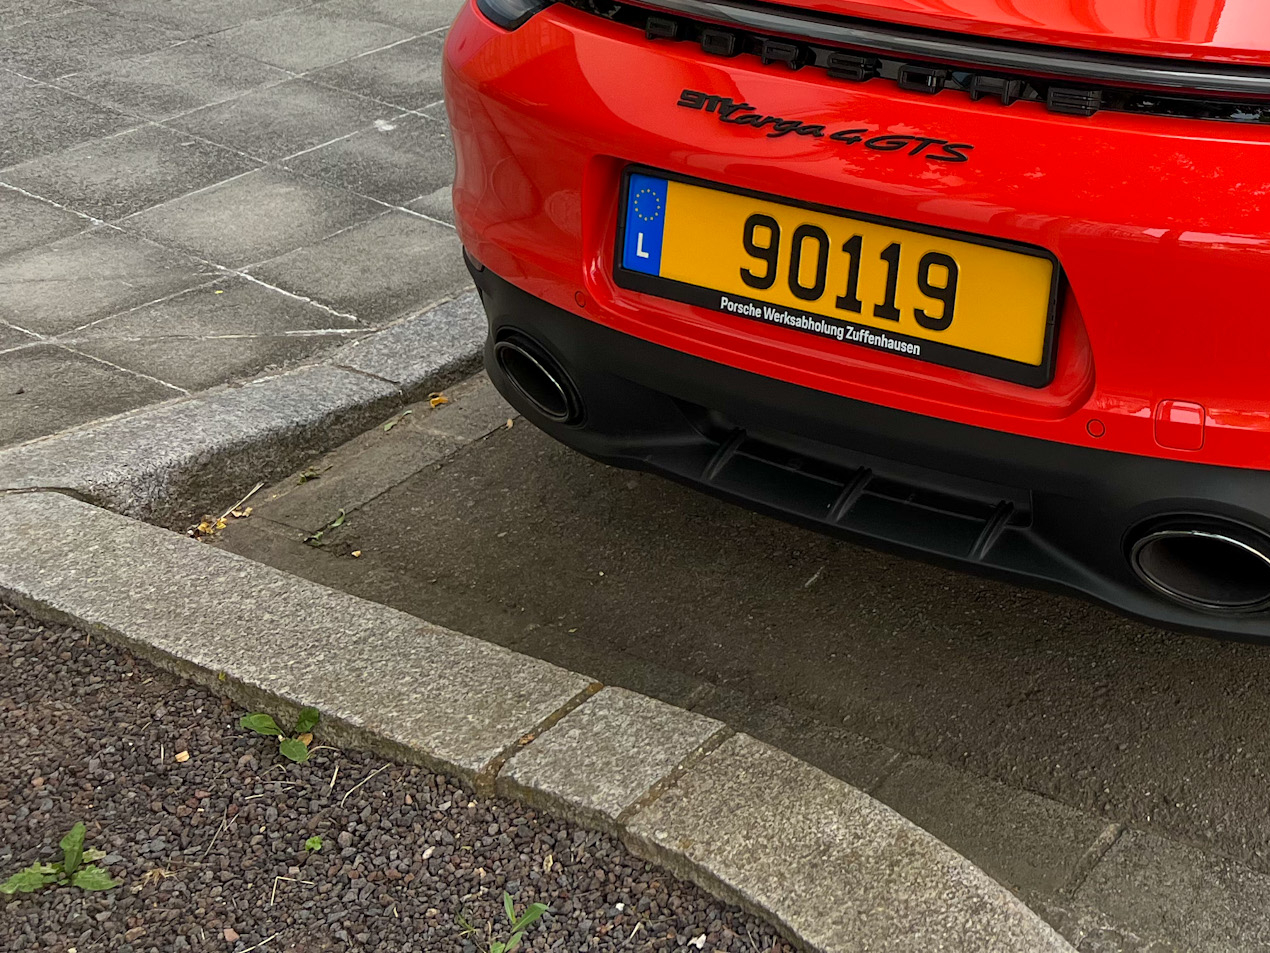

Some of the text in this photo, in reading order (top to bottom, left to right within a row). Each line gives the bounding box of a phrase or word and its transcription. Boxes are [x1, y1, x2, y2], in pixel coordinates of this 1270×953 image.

[645, 15, 1101, 117] PORSCHE
[830, 128, 868, 145] 4
[864, 134, 975, 163] GTS
[636, 232, 650, 259] L
[739, 213, 960, 332] 90119
[720, 296, 921, 356] Porsche Werksabholung Zuffenhausen
